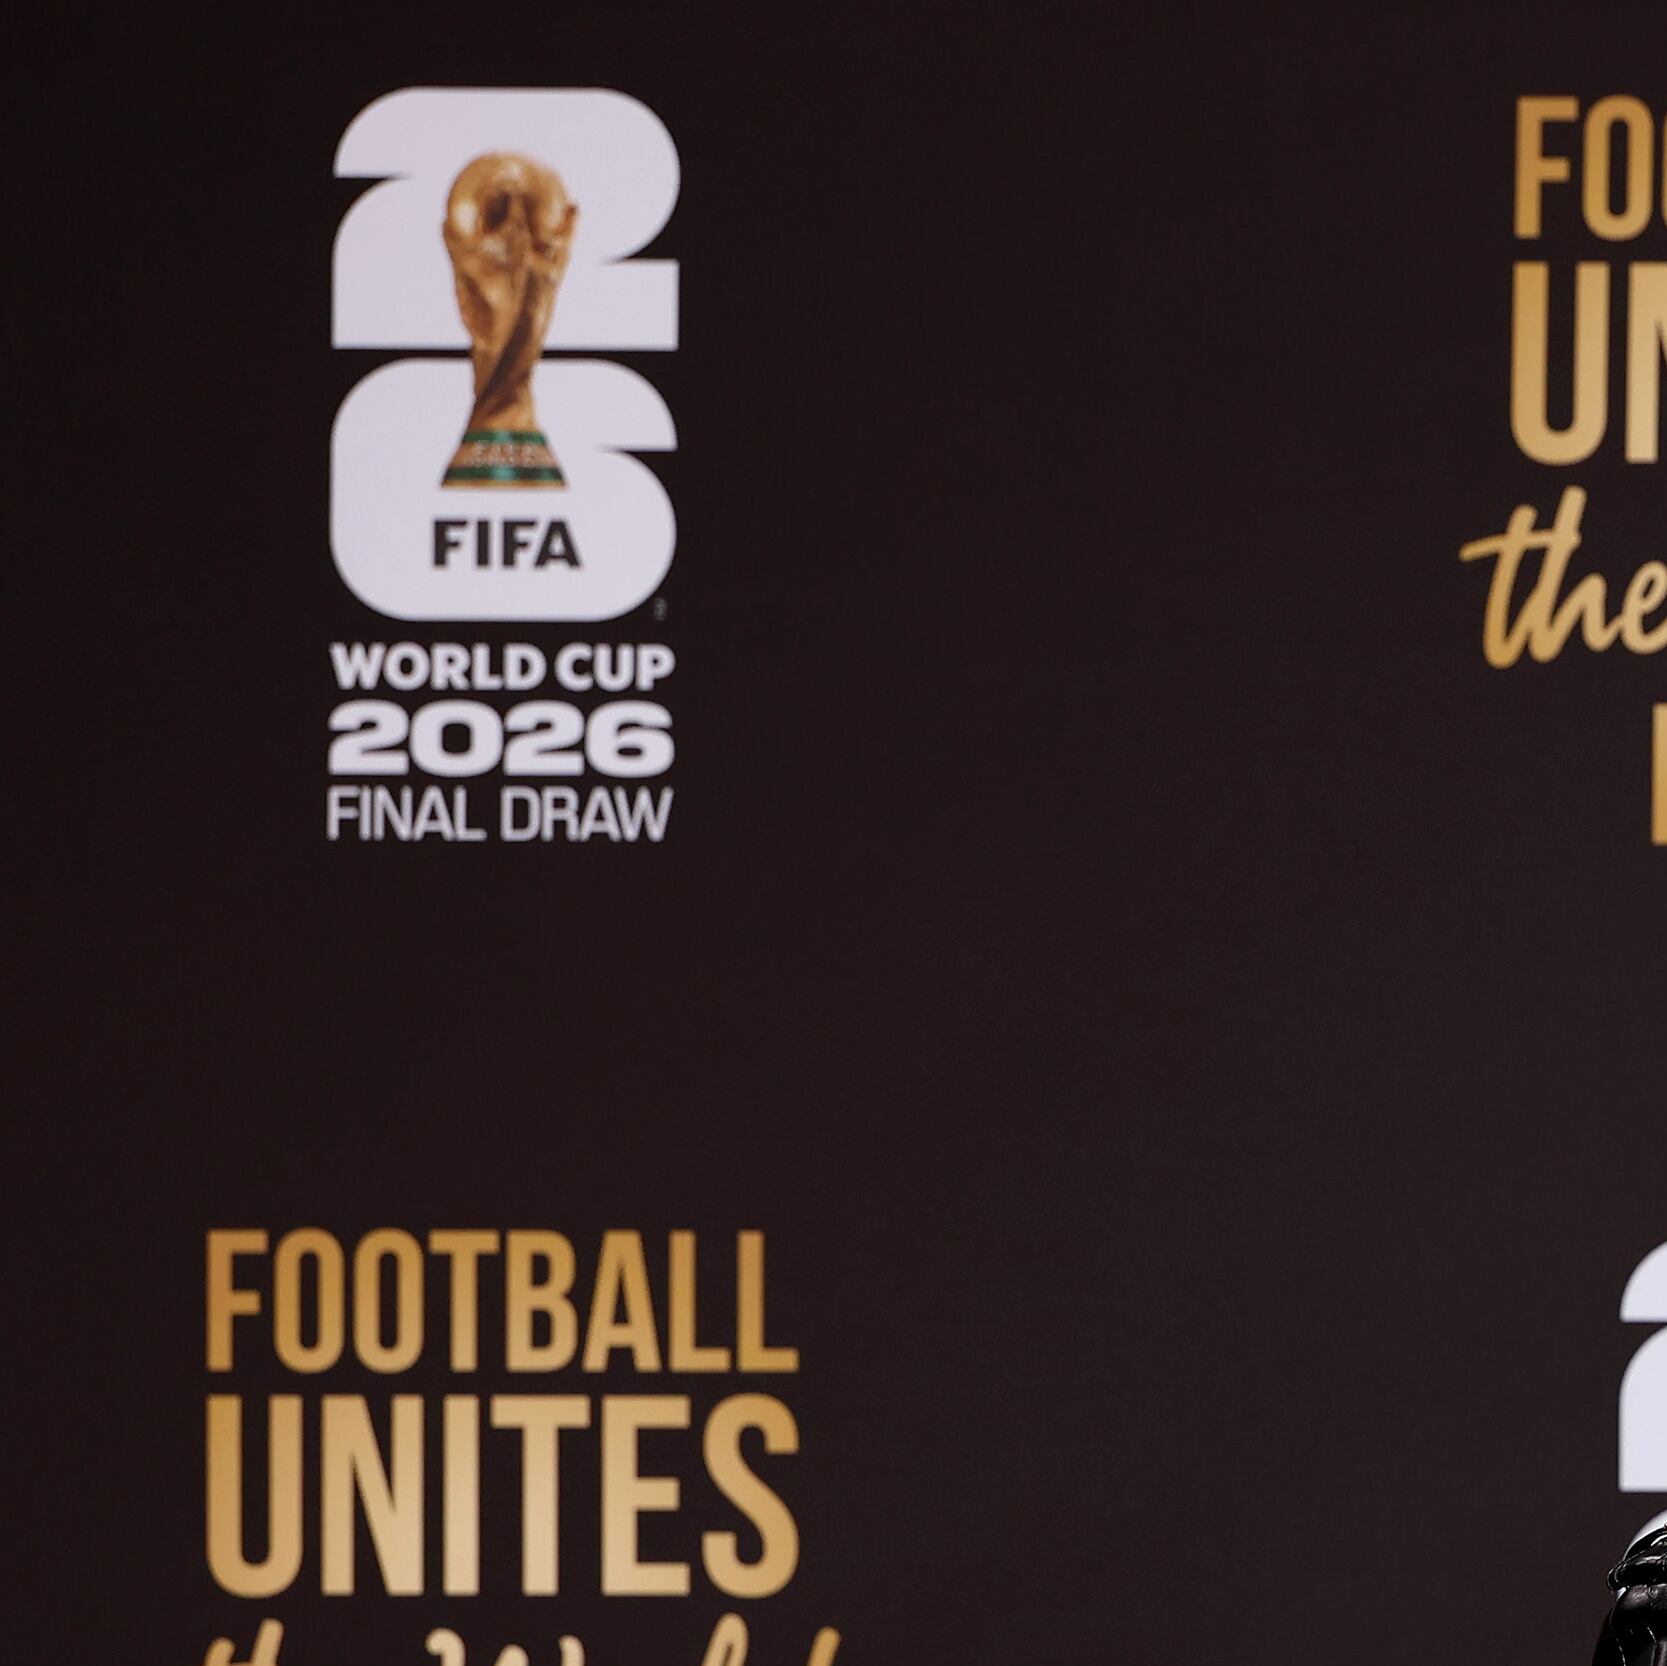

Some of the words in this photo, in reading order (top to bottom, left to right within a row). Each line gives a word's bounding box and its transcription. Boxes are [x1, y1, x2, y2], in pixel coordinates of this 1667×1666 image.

[434, 520, 580, 568] FIFA
[330, 643, 546, 690] WORLD
[556, 644, 675, 691] CUP
[329, 700, 674, 777] 2026
[328, 786, 486, 841] FINAL
[501, 786, 673, 841] DRAW
[207, 1229, 798, 1373] FOOTBALL
[207, 1394, 798, 1597] UNITES
